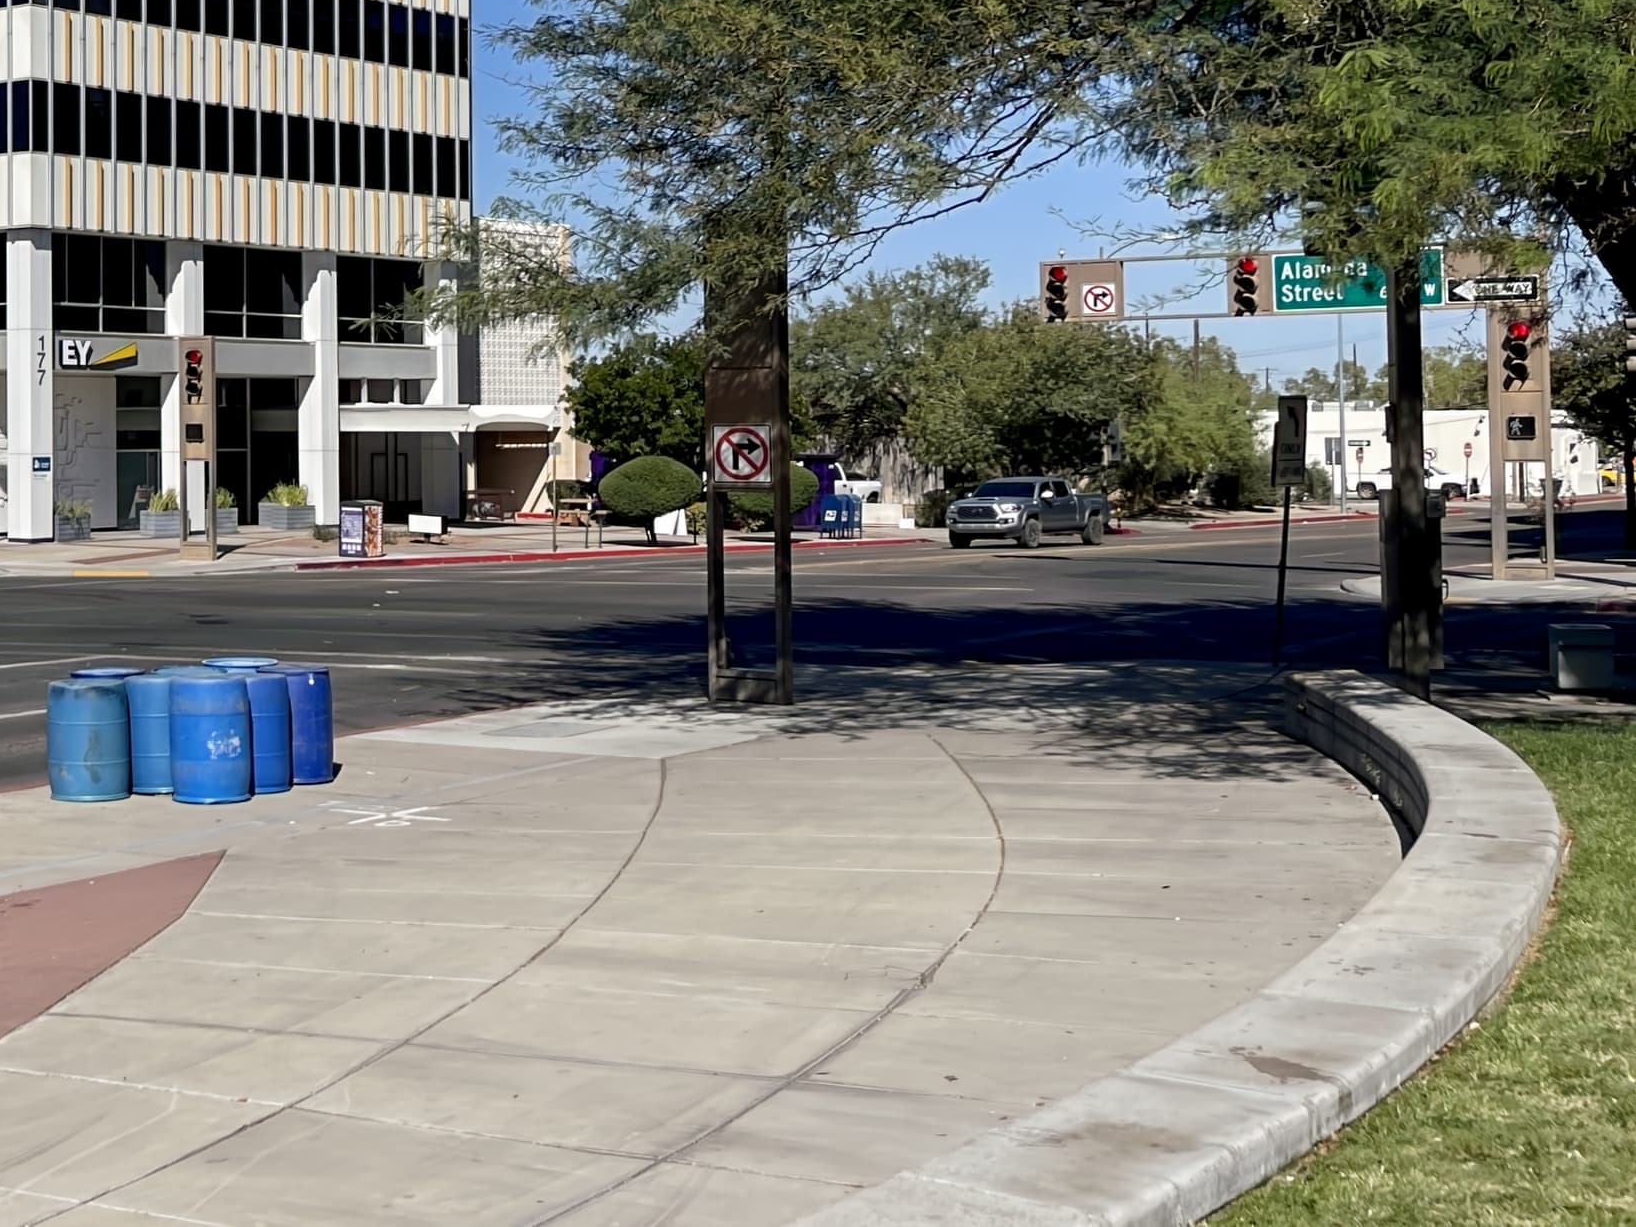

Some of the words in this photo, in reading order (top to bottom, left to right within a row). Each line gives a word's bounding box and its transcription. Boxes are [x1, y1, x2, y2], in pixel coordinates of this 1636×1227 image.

[1281, 283, 1344, 303] Street
[1424, 283, 1436, 297] W
[1474, 284, 1499, 296] ONE
[1503, 282, 1531, 294] WAY
[36, 335, 46, 386] 177
[61, 339, 92, 366] EY
